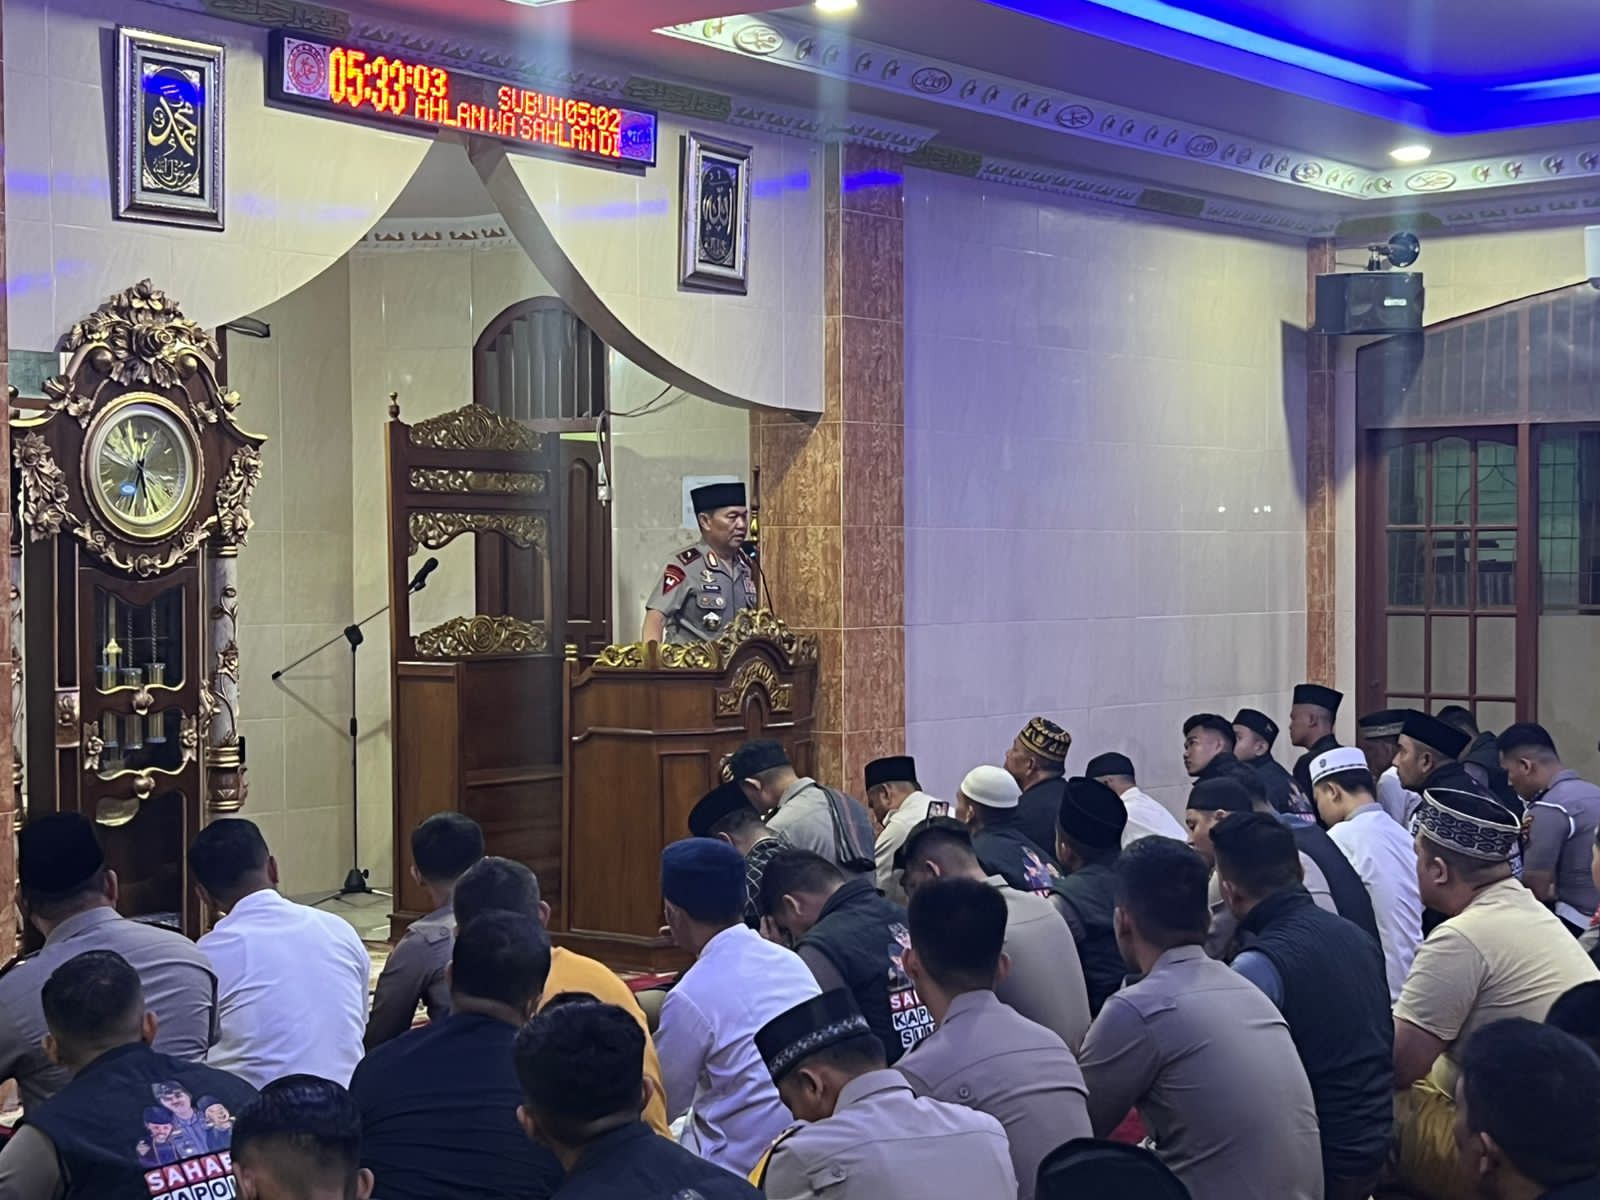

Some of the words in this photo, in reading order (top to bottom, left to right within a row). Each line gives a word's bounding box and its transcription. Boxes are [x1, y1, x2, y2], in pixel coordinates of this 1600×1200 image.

[415, 95, 486, 131] AHLAN
[488, 109, 516, 137] WA
[519, 112, 597, 153] SAHLAN
[599, 129, 620, 157] DI
[893, 1008, 934, 1028] KAP
